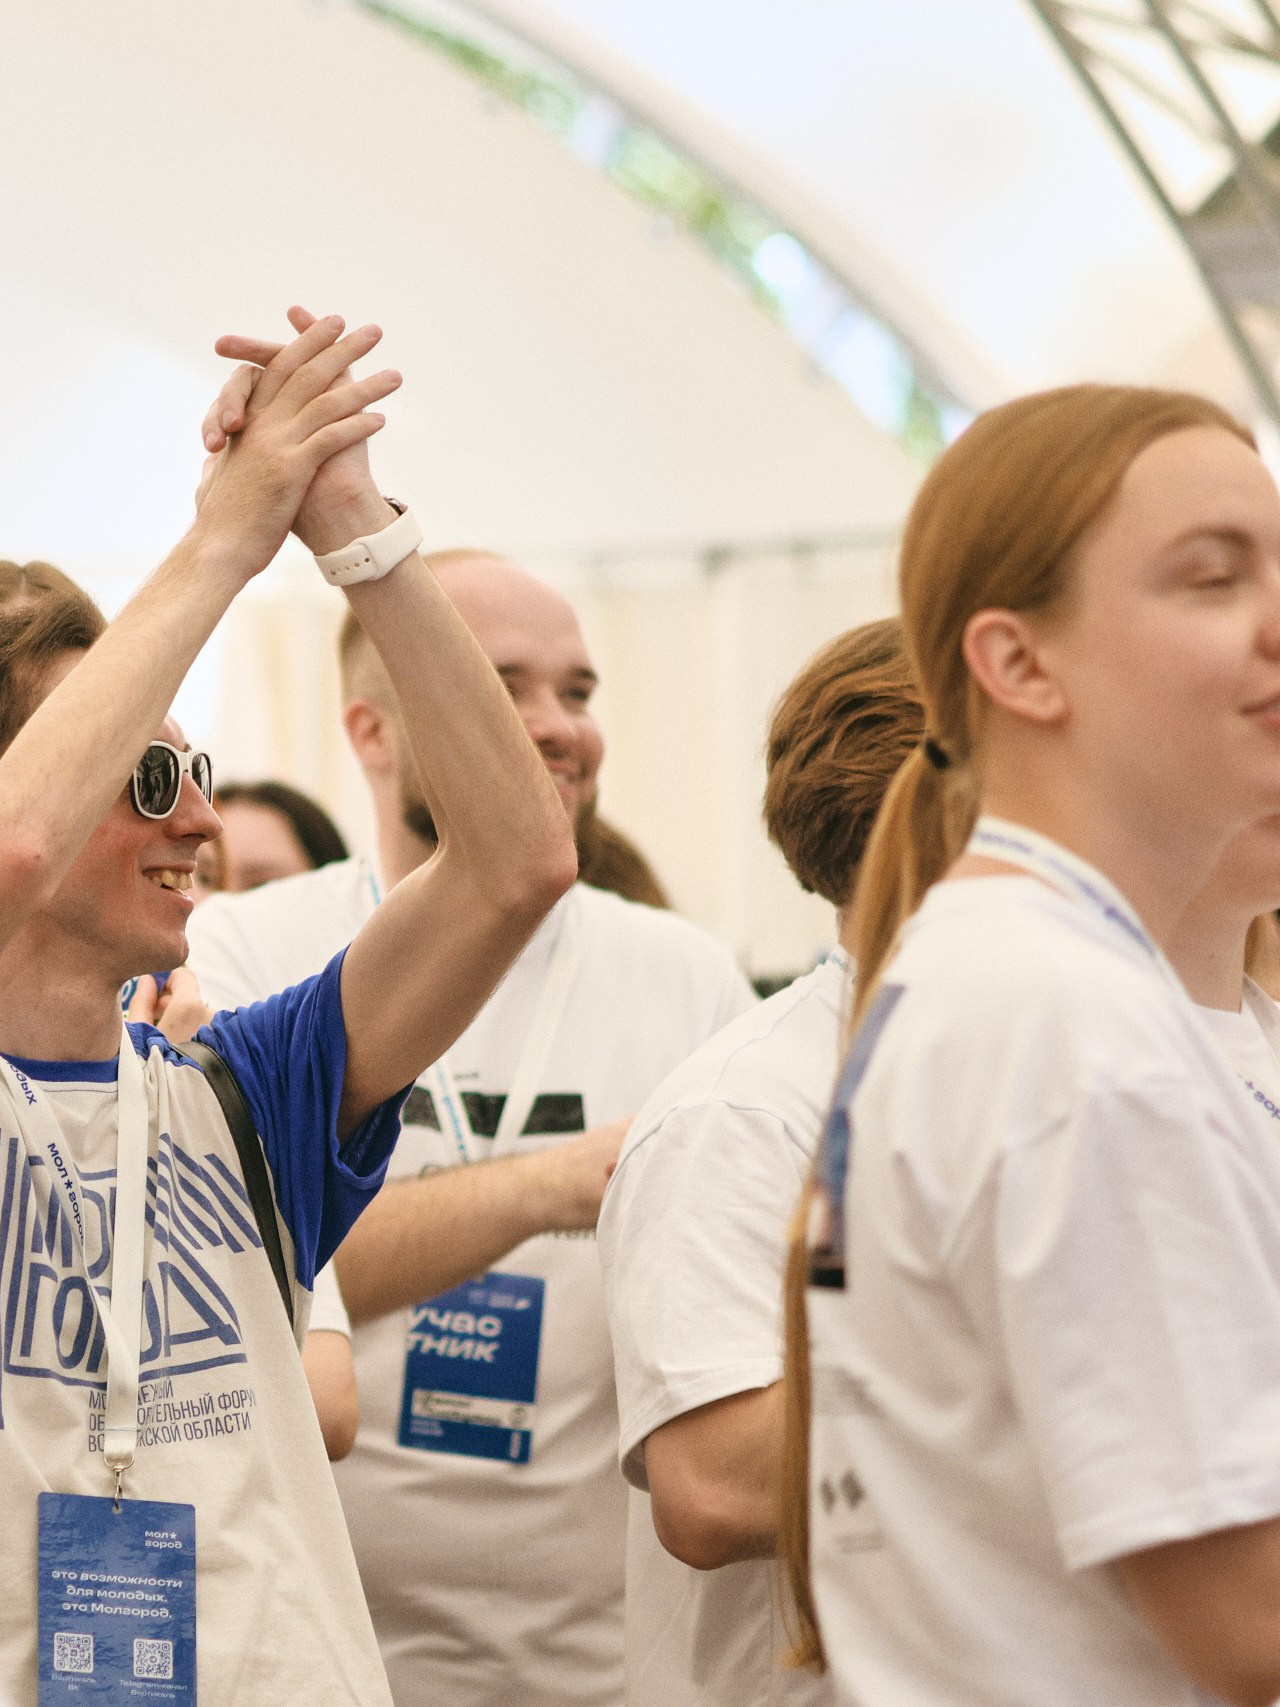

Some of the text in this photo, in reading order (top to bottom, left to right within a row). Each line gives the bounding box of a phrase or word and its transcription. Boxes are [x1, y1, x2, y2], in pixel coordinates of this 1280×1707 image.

[47, 1142, 69, 1178] мол
[183, 1411, 252, 1441] ОБЛАСТИ
[145, 1540, 182, 1549] город
[51, 1570, 183, 1589] это возможности
[66, 1585, 168, 1603] для молодых.
[62, 1602, 173, 1619] это Молгород.
[51, 1673, 97, 1684] Вертикаль
[130, 1689, 177, 1699] Вертикаль
